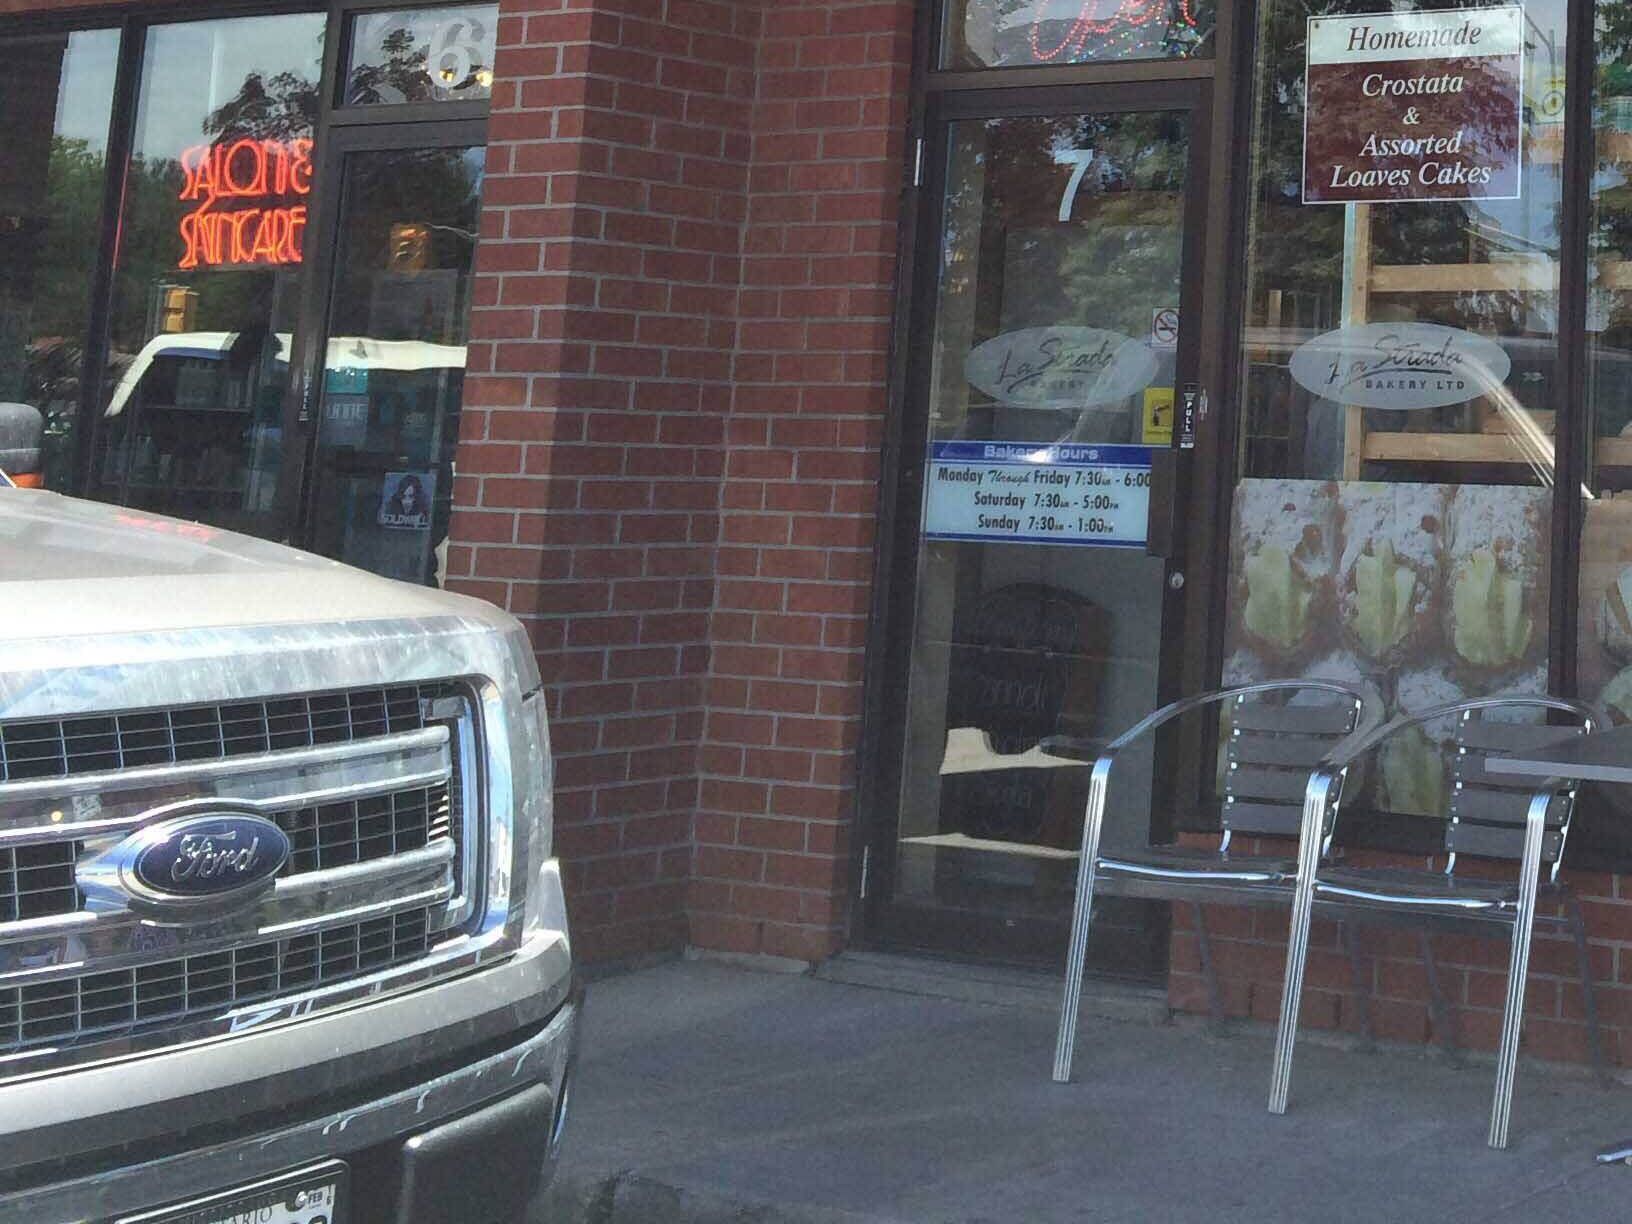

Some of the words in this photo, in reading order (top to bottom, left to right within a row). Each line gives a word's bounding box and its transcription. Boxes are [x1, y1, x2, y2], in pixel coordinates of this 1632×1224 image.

[1346, 21, 1482, 52] Homemade
[428, 16, 484, 88] 6
[1362, 73, 1464, 97] Crostata
[1402, 106, 1421, 125] &
[1359, 130, 1463, 156] Assorted
[1054, 148, 1094, 223] 7
[1330, 164, 1411, 188] Loaves
[1418, 161, 1492, 186] Cakes
[1365, 380, 1428, 391] BAKERY
[1436, 380, 1466, 391] LTD
[983, 444, 1043, 462] Baker
[937, 466, 984, 487] Monday
[1034, 468, 1070, 489] Friday
[974, 490, 1026, 510] Saturday
[978, 513, 1020, 533] Sunday
[170, 830, 260, 882] Ford
